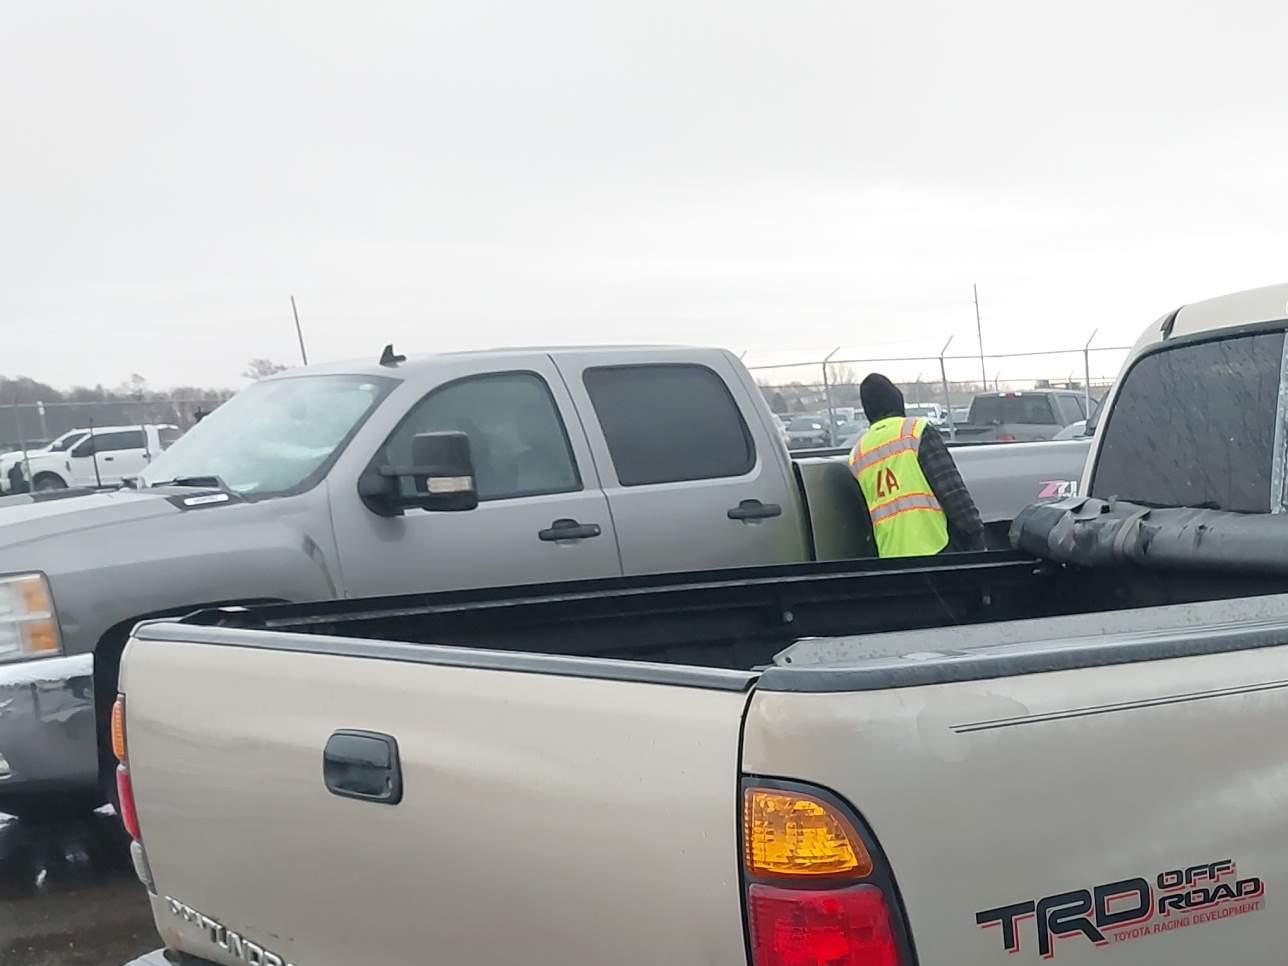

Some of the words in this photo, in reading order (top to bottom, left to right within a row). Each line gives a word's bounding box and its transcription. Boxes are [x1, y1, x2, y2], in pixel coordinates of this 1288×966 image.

[1157, 858, 1236, 892] OFF
[1158, 877, 1265, 916] ROAD
[975, 877, 1154, 960] TRD
[1113, 926, 1151, 943] TOYOTA
[1153, 916, 1191, 934] RACING
[1192, 901, 1261, 925] DEVELOPMENT
